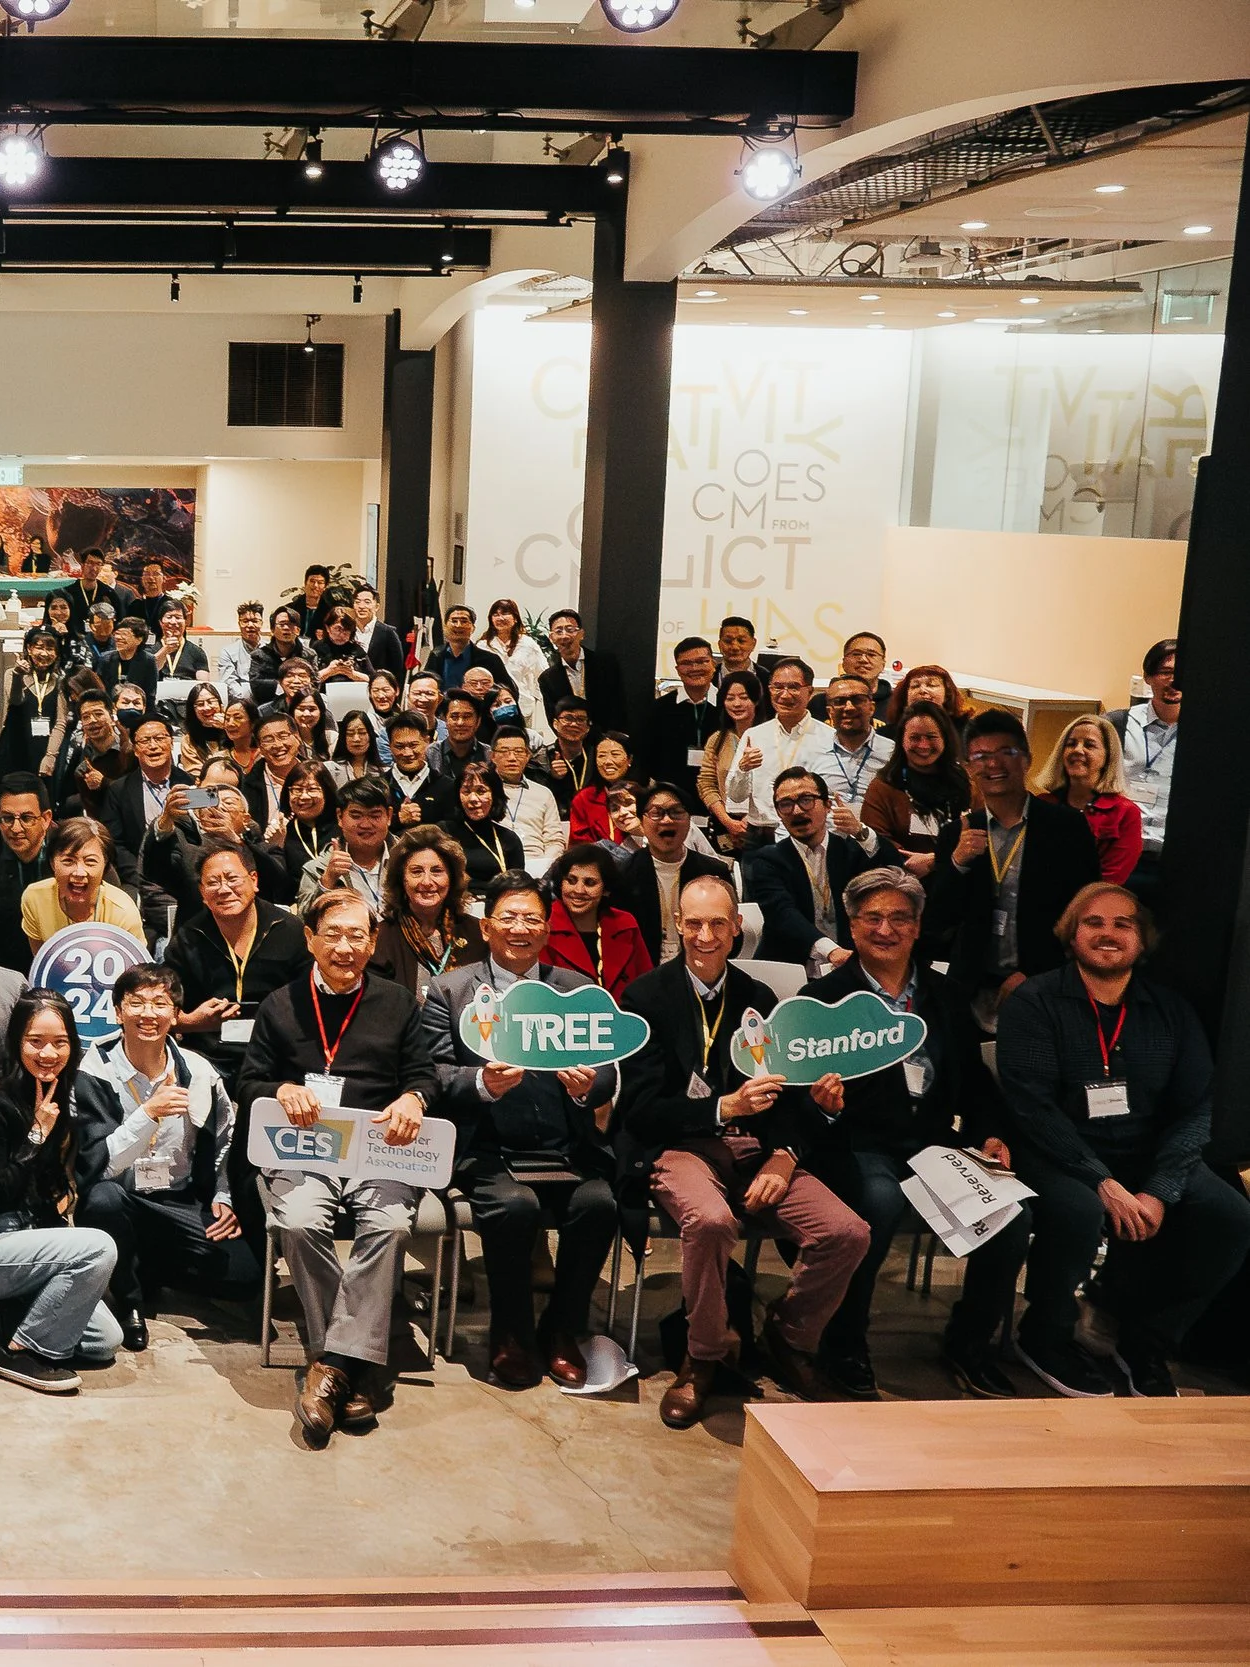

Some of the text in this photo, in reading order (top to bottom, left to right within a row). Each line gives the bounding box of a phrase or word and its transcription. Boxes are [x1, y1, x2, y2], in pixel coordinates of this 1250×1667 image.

[772, 519, 810, 531] FROM
[662, 620, 685, 635] OF
[63, 948, 126, 985] 20
[64, 988, 117, 1025] 24
[512, 1013, 615, 1052] TREE
[787, 1020, 905, 1062] Stanford
[274, 1127, 335, 1158] CES
[366, 1141, 440, 1163] Technology
[365, 1155, 437, 1173] Association
[941, 1153, 998, 1205] Reserved
